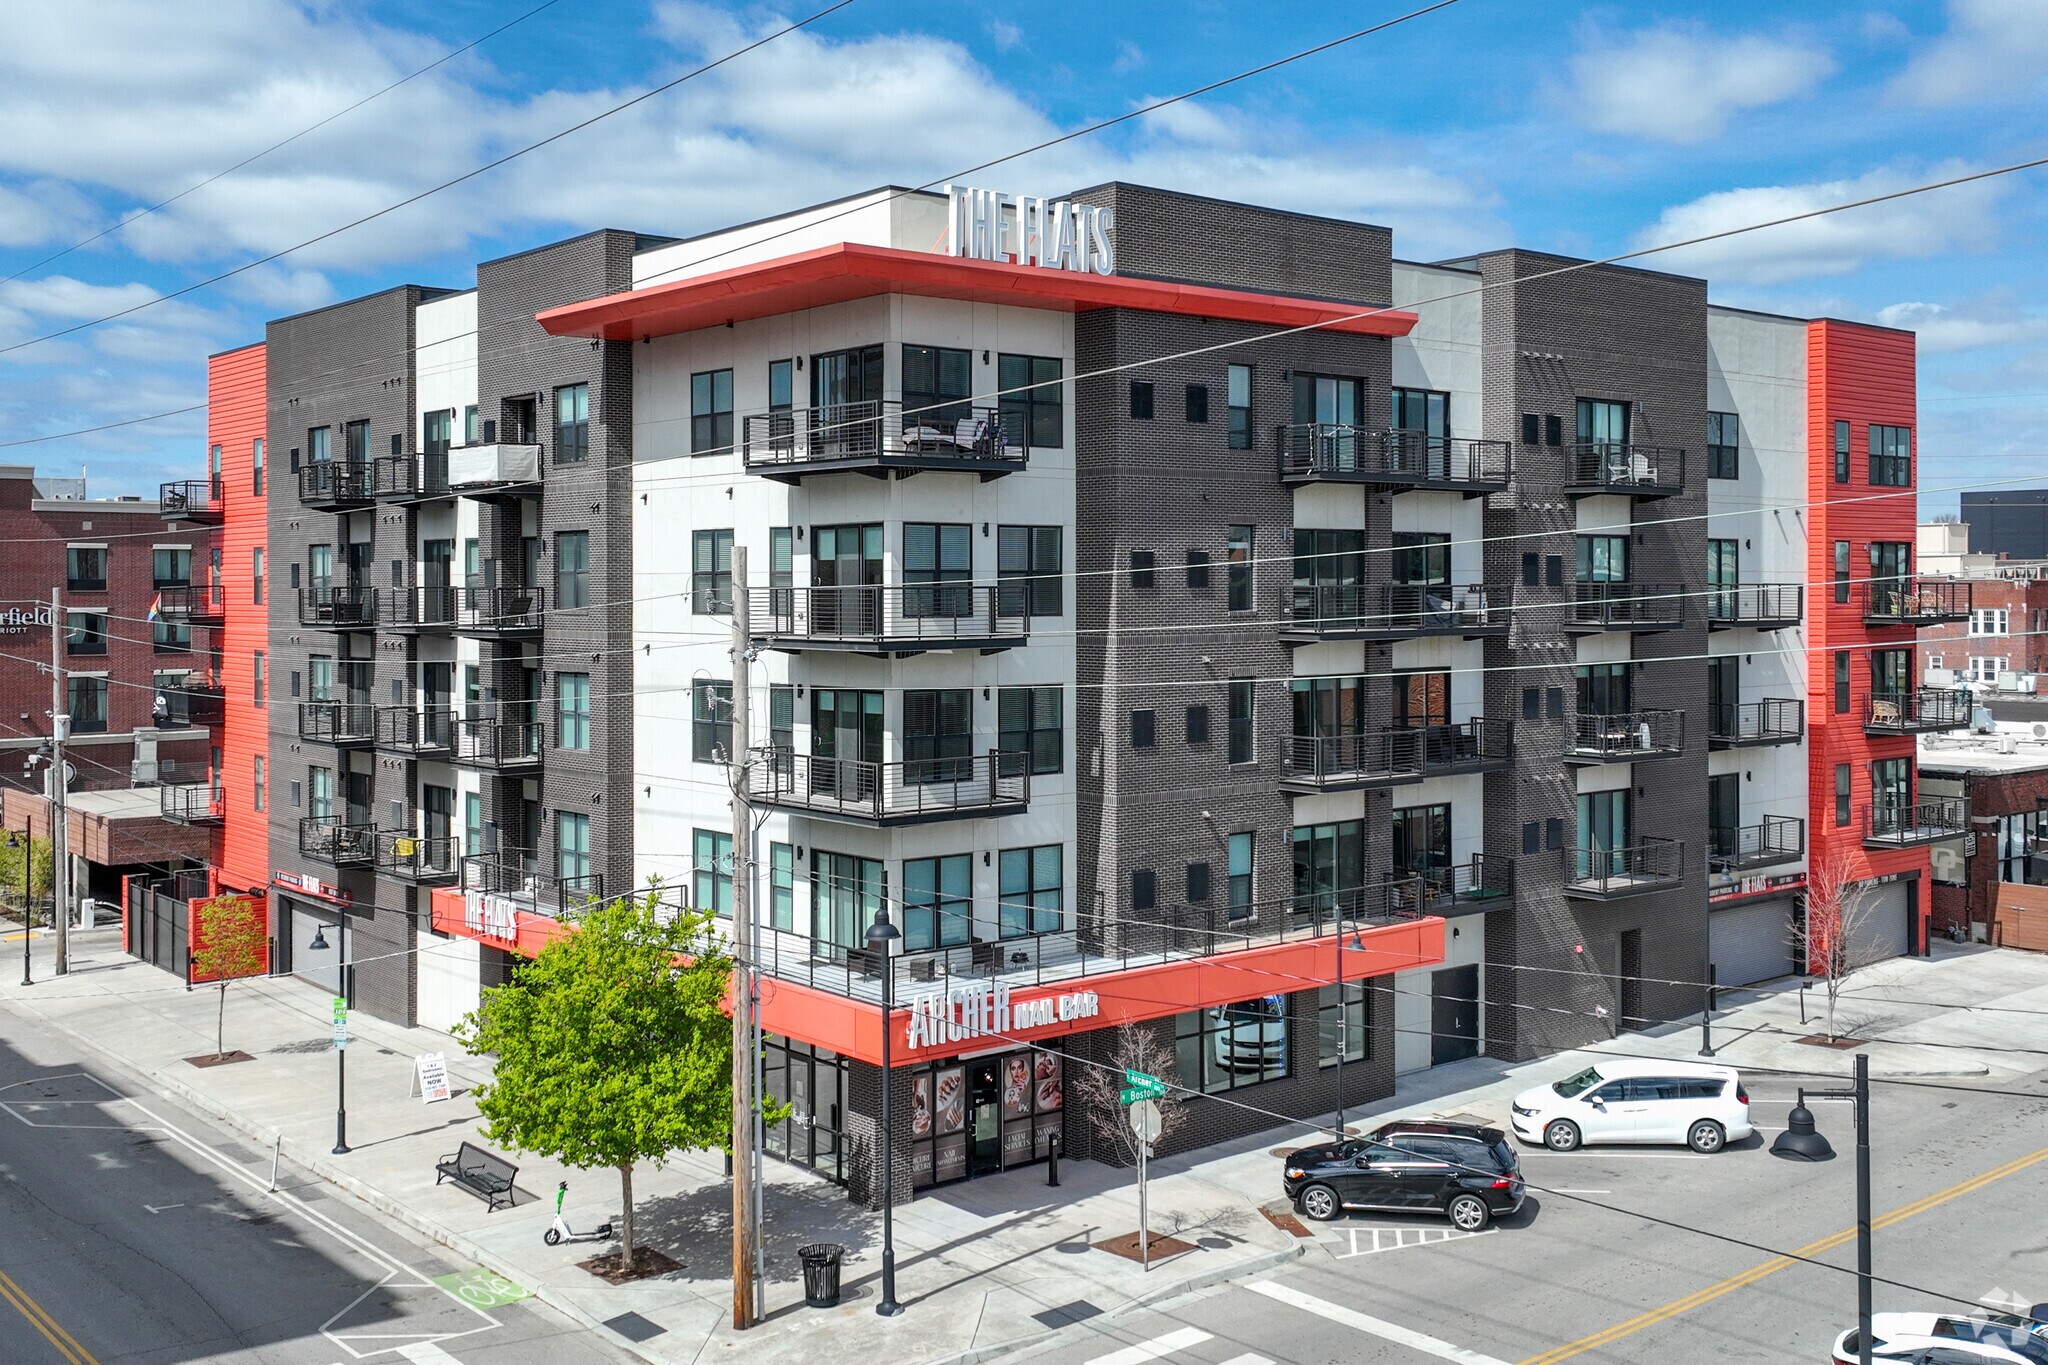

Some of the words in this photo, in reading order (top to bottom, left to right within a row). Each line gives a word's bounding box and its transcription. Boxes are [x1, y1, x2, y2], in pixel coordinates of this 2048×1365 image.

[944, 184, 1010, 263] THE
[1016, 195, 1114, 276] FLATS
[1751, 874, 1767, 893] FLATS
[465, 890, 484, 932] THE
[484, 895, 516, 941] FLATS
[908, 983, 1010, 1050] ARCHER
[1013, 998, 1058, 1030] NAIL
[1059, 991, 1099, 1022] BAR
[427, 1078, 442, 1086] NOW
[1131, 1073, 1152, 1087] Archer
[1130, 1089, 1155, 1101] Boston
[1004, 1139, 1031, 1151] SERVICES
